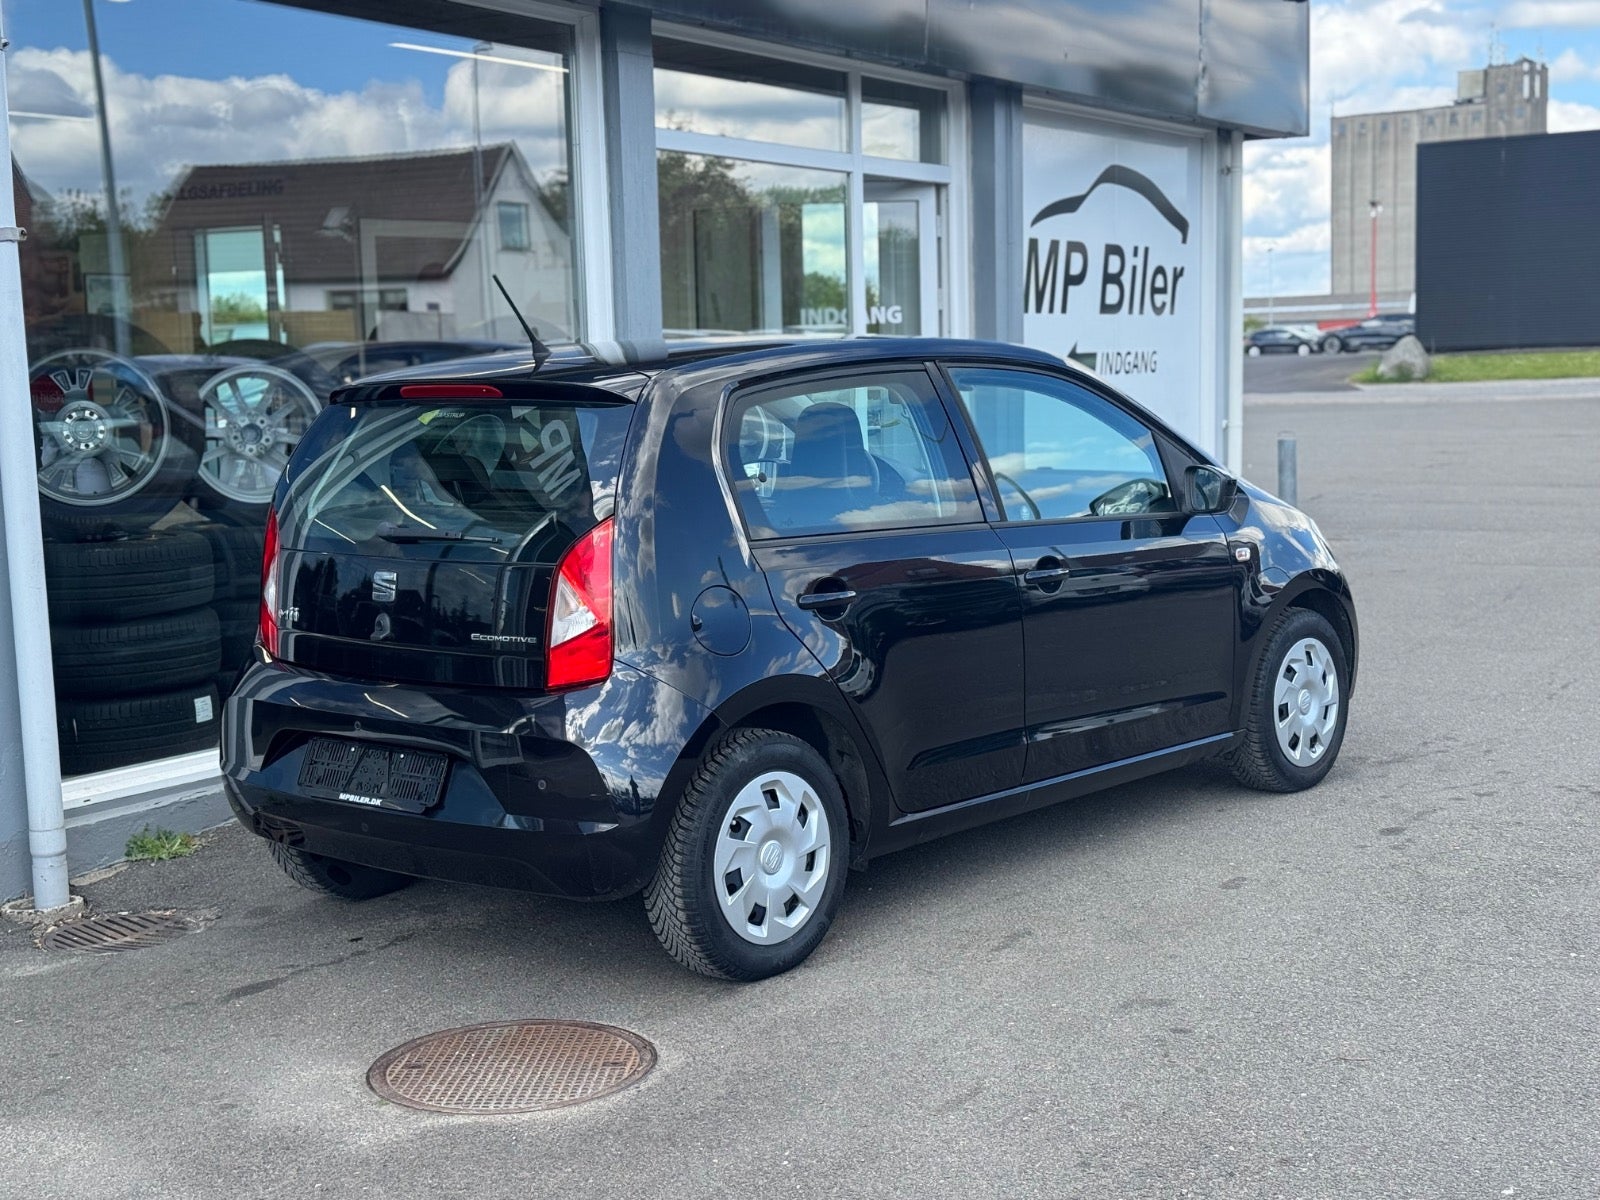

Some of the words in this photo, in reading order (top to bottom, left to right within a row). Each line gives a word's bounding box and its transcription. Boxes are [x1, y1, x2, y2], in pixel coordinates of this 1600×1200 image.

[1023, 238, 1088, 314] MP
[1099, 244, 1184, 316] Biler
[1101, 351, 1157, 375] INDGANG
[338, 792, 383, 806] MPBILER.DK
